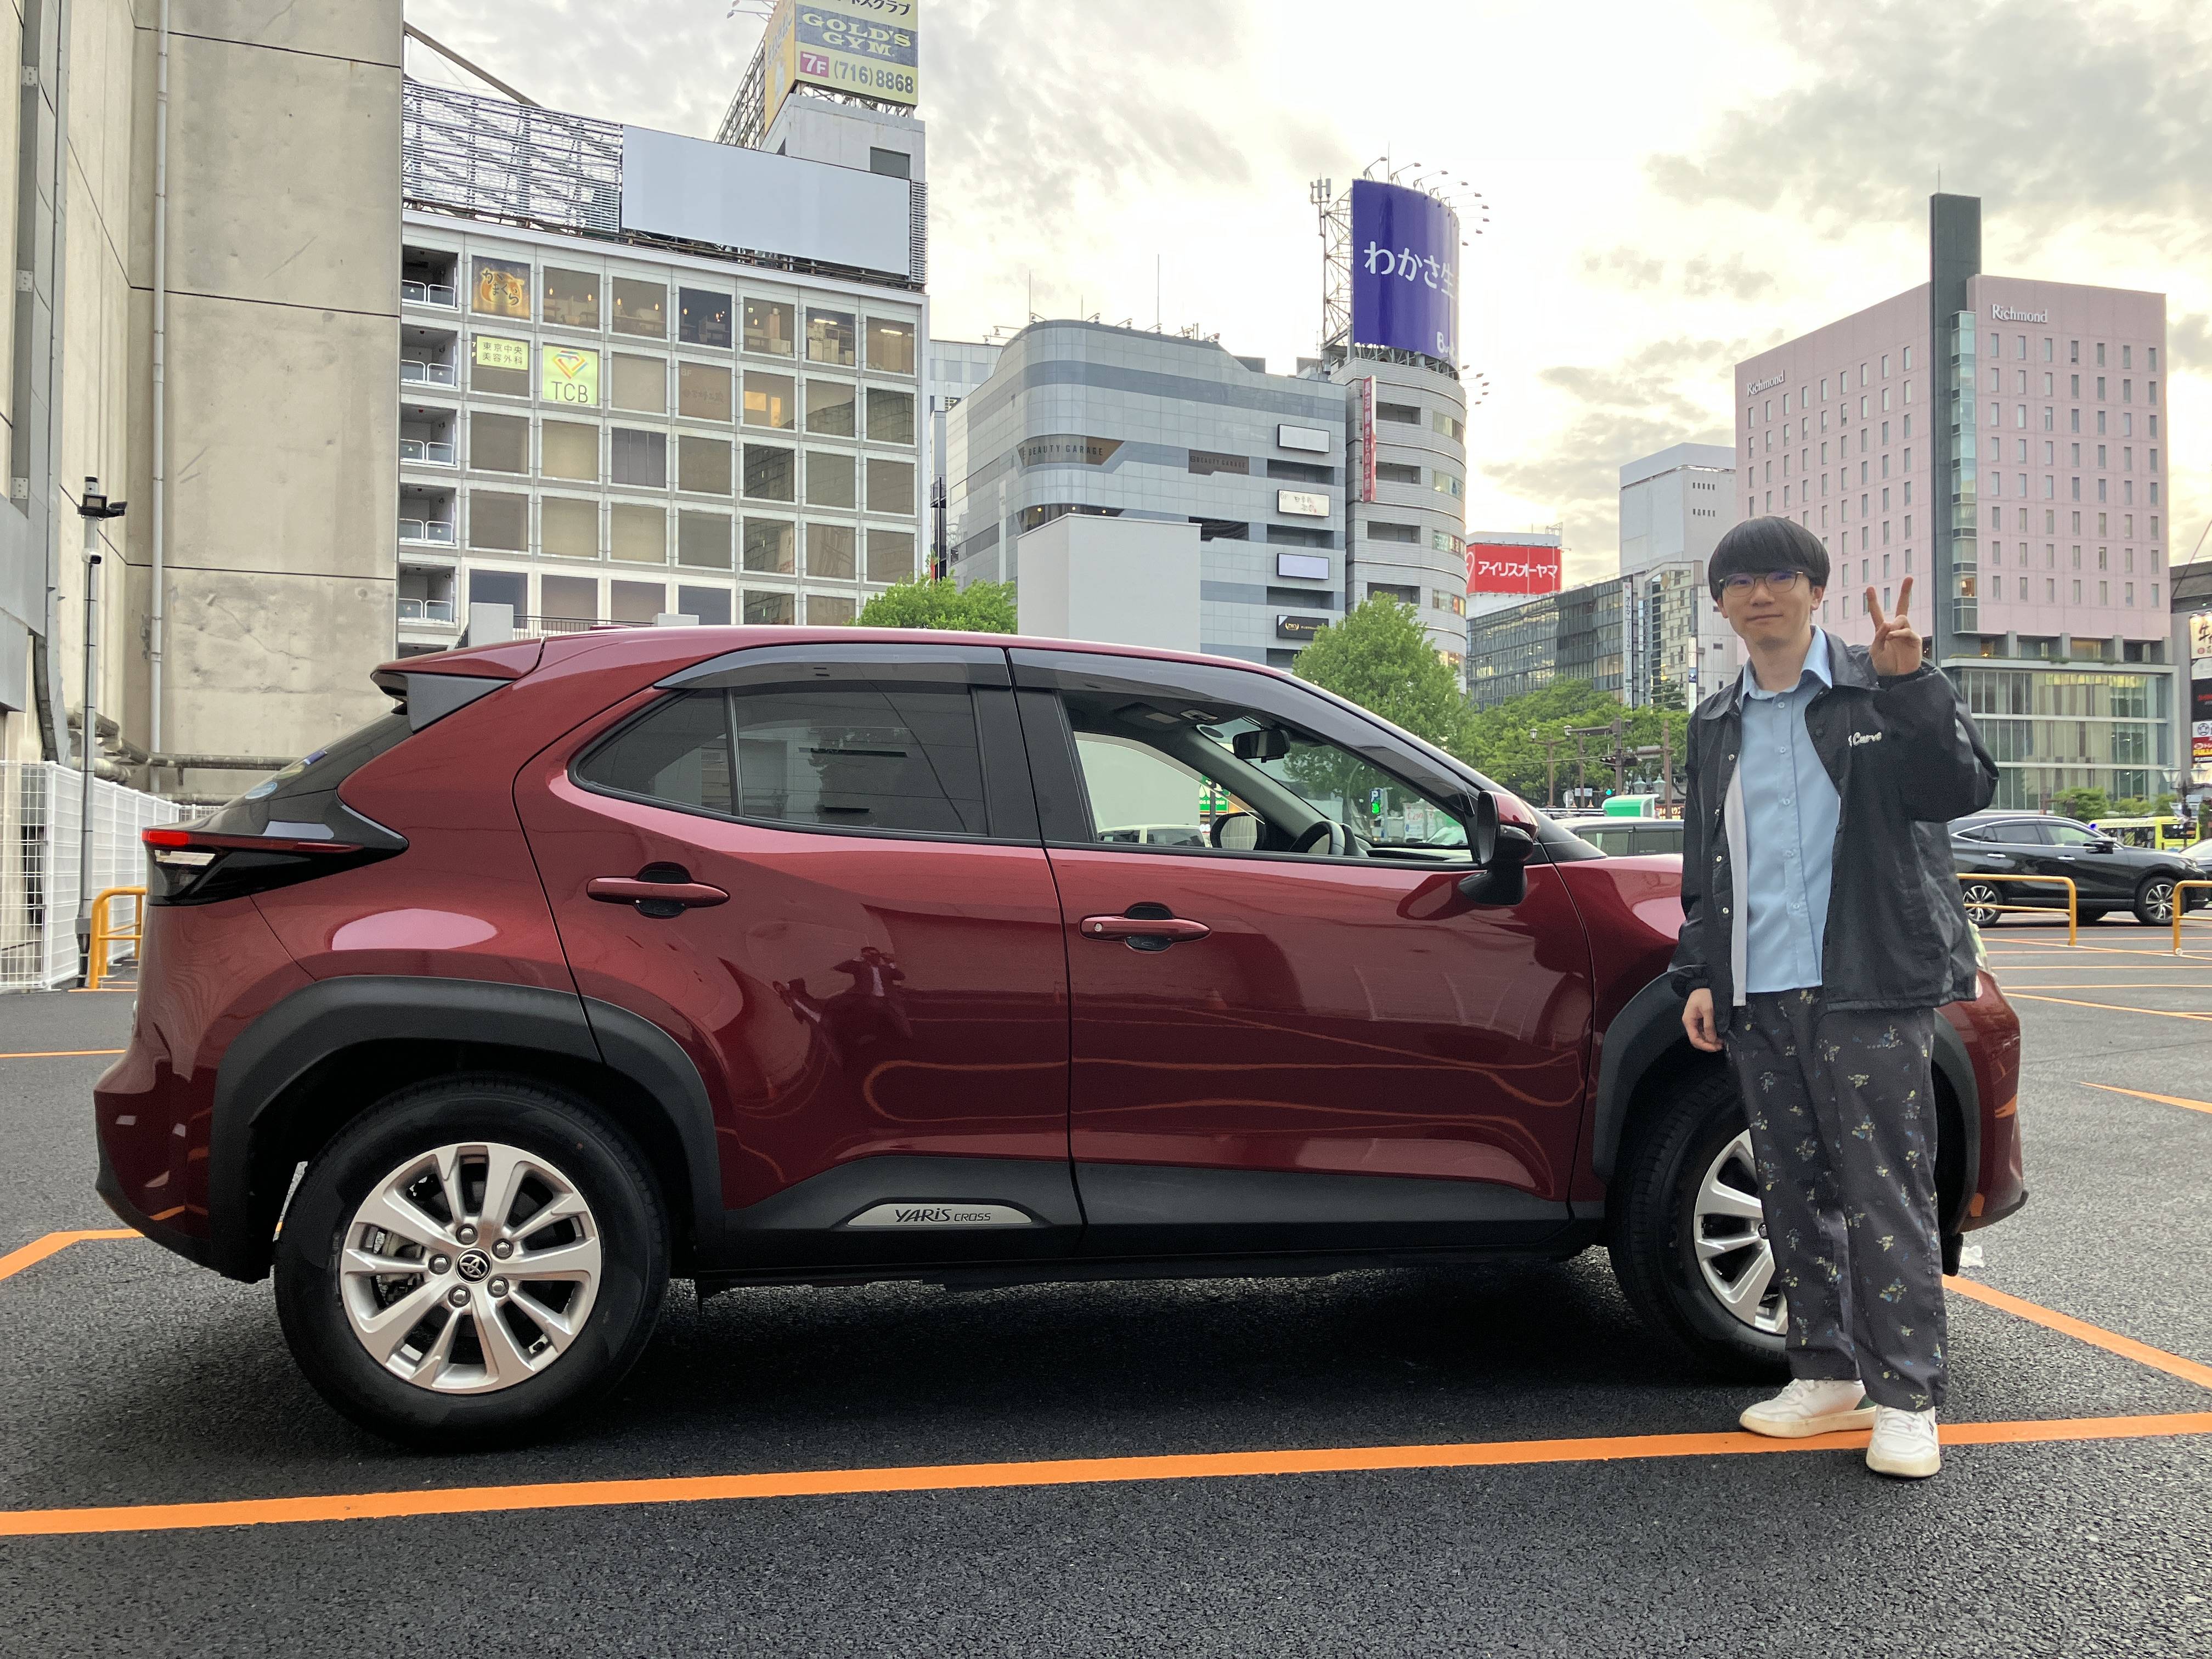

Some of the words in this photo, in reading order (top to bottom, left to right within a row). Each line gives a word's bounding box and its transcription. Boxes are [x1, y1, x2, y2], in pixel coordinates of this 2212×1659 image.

[803, 13, 911, 47] GOLD'S
[823, 31, 893, 57] GYM
[803, 54, 826, 74] 7F
[834, 60, 914, 94] (716)8868
[1991, 303, 2048, 323] Richmond
[483, 342, 523, 355] 東京中央
[483, 352, 523, 365] 美容外科
[551, 381, 588, 403] TCB
[1747, 370, 1785, 396] Richmond
[1029, 445, 1060, 456] BEAUTY
[1065, 445, 1103, 456] GARAGE
[1197, 456, 1220, 465] BEAUTY
[1222, 459, 1246, 469] GARAGE
[1478, 561, 1558, 579] アイリスオーヤマ
[954, 1212, 991, 1222] CROSS
